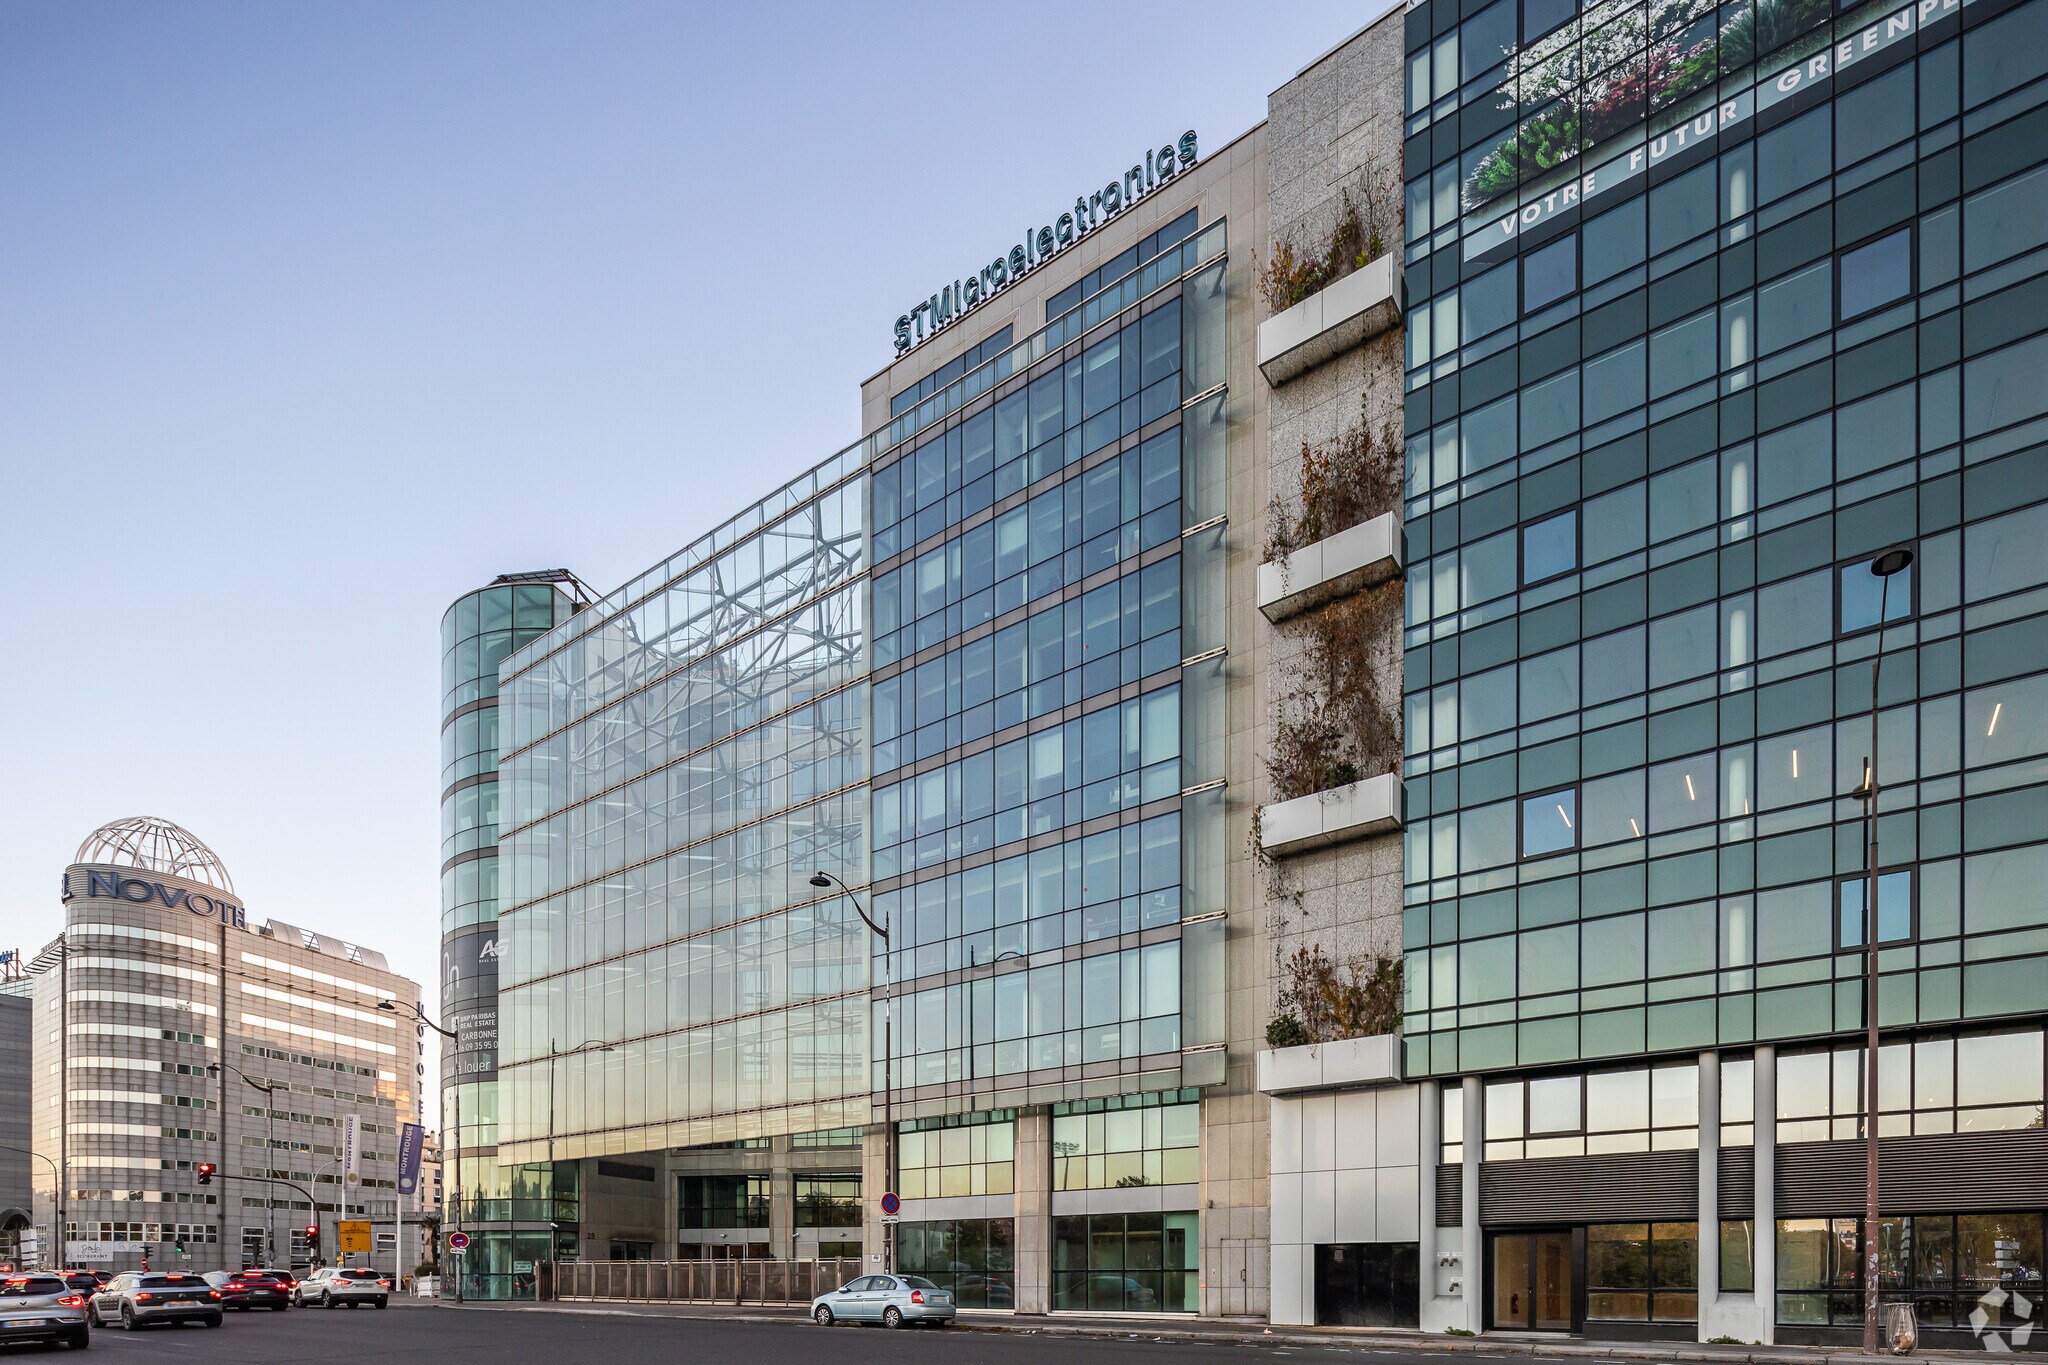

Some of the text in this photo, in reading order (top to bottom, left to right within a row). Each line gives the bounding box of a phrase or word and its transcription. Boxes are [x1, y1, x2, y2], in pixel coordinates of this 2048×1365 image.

[1500, 172, 1597, 235] VOTRE
[1629, 101, 1738, 171] FUTUR
[893, 129, 1199, 353] STMicroelectronics
[471, 1012, 496, 1020] PARIBAS
[474, 1019, 496, 1027] ESTATE
[461, 1030, 497, 1041] CARBONNE
[464, 1060, 491, 1073] louer
[346, 1116, 354, 1169] MONTROUGE
[400, 1125, 414, 1175] MONTROUGE
[586, 1232, 596, 1240] 25
